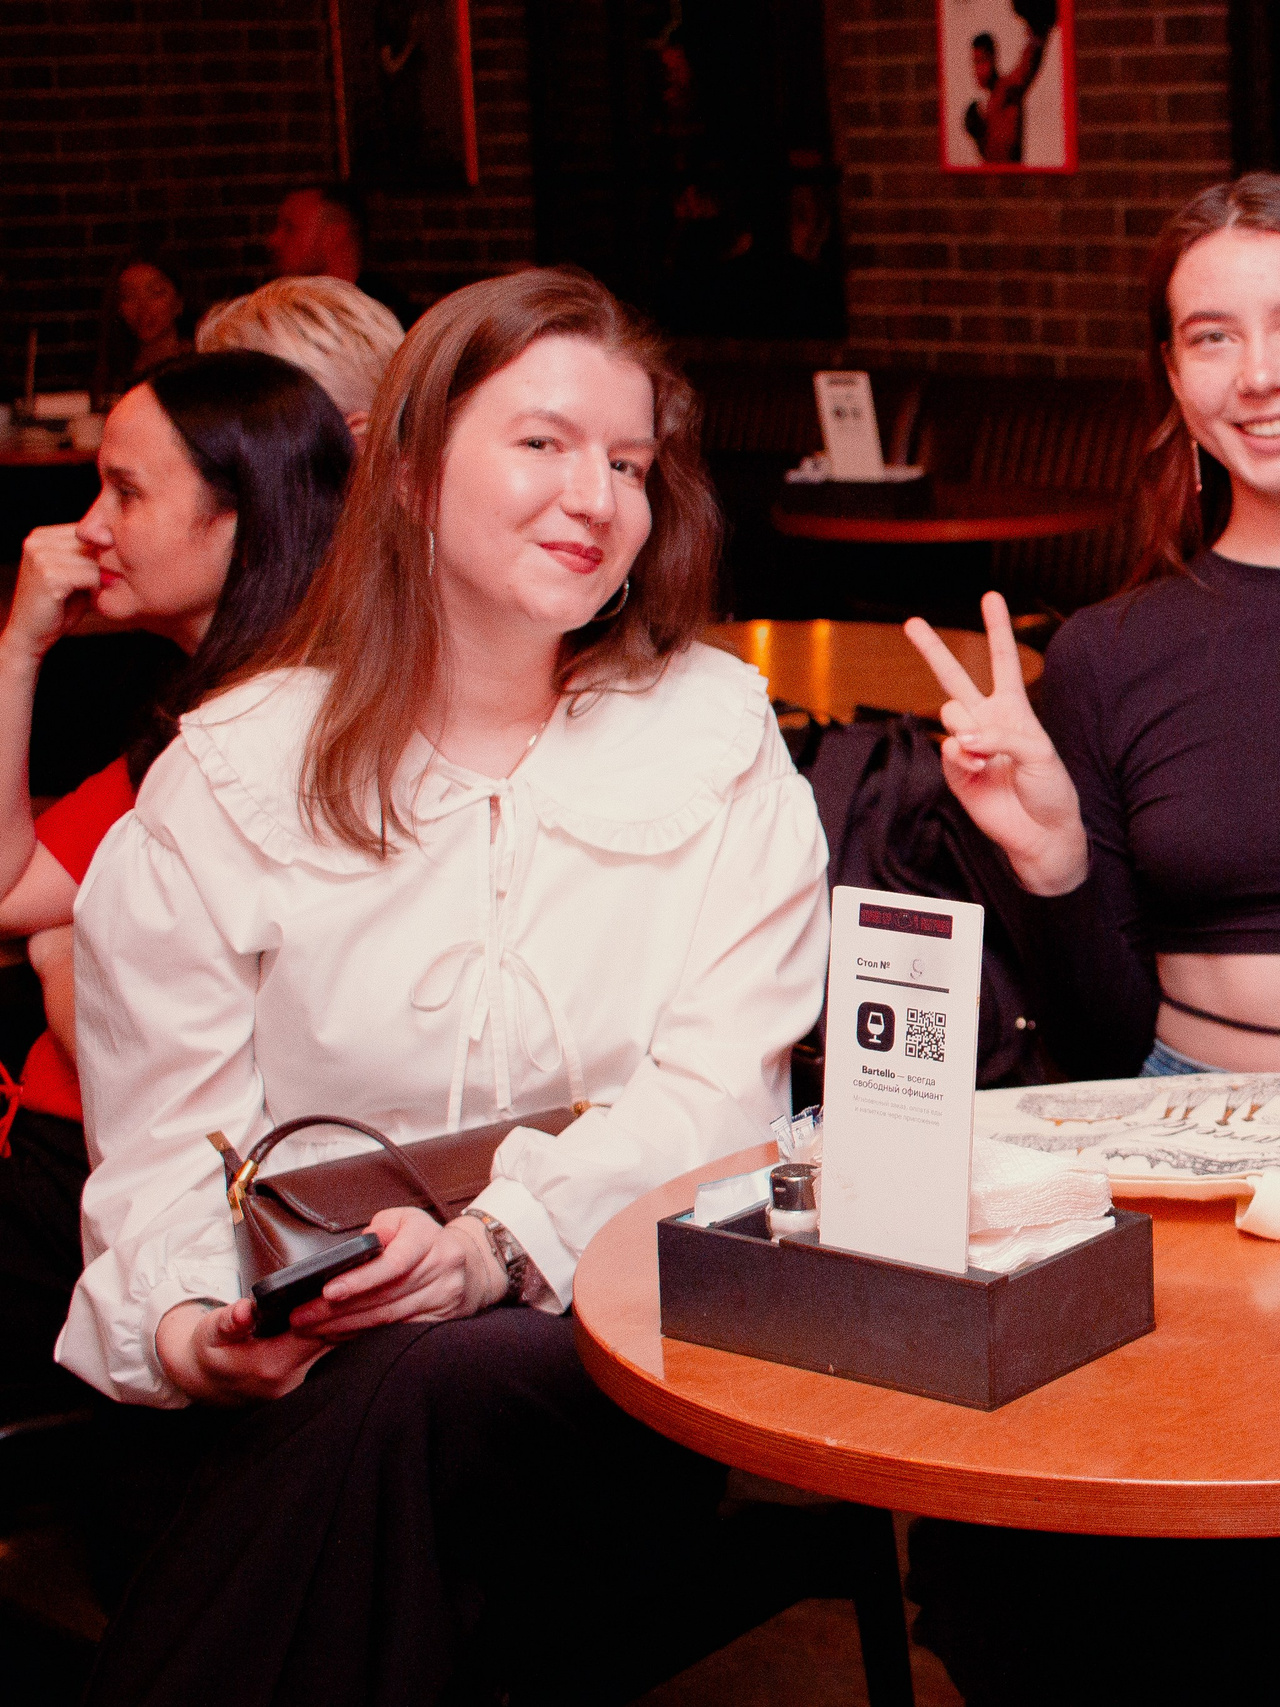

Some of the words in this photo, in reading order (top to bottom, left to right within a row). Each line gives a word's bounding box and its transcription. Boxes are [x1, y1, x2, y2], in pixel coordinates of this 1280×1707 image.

[857, 957, 878, 969] Стол
[880, 960, 890, 969] №
[861, 1065, 896, 1079] Bartello
[907, 1074, 936, 1086] всегда
[852, 1079, 900, 1094] свободный
[901, 1086, 944, 1101] официант
